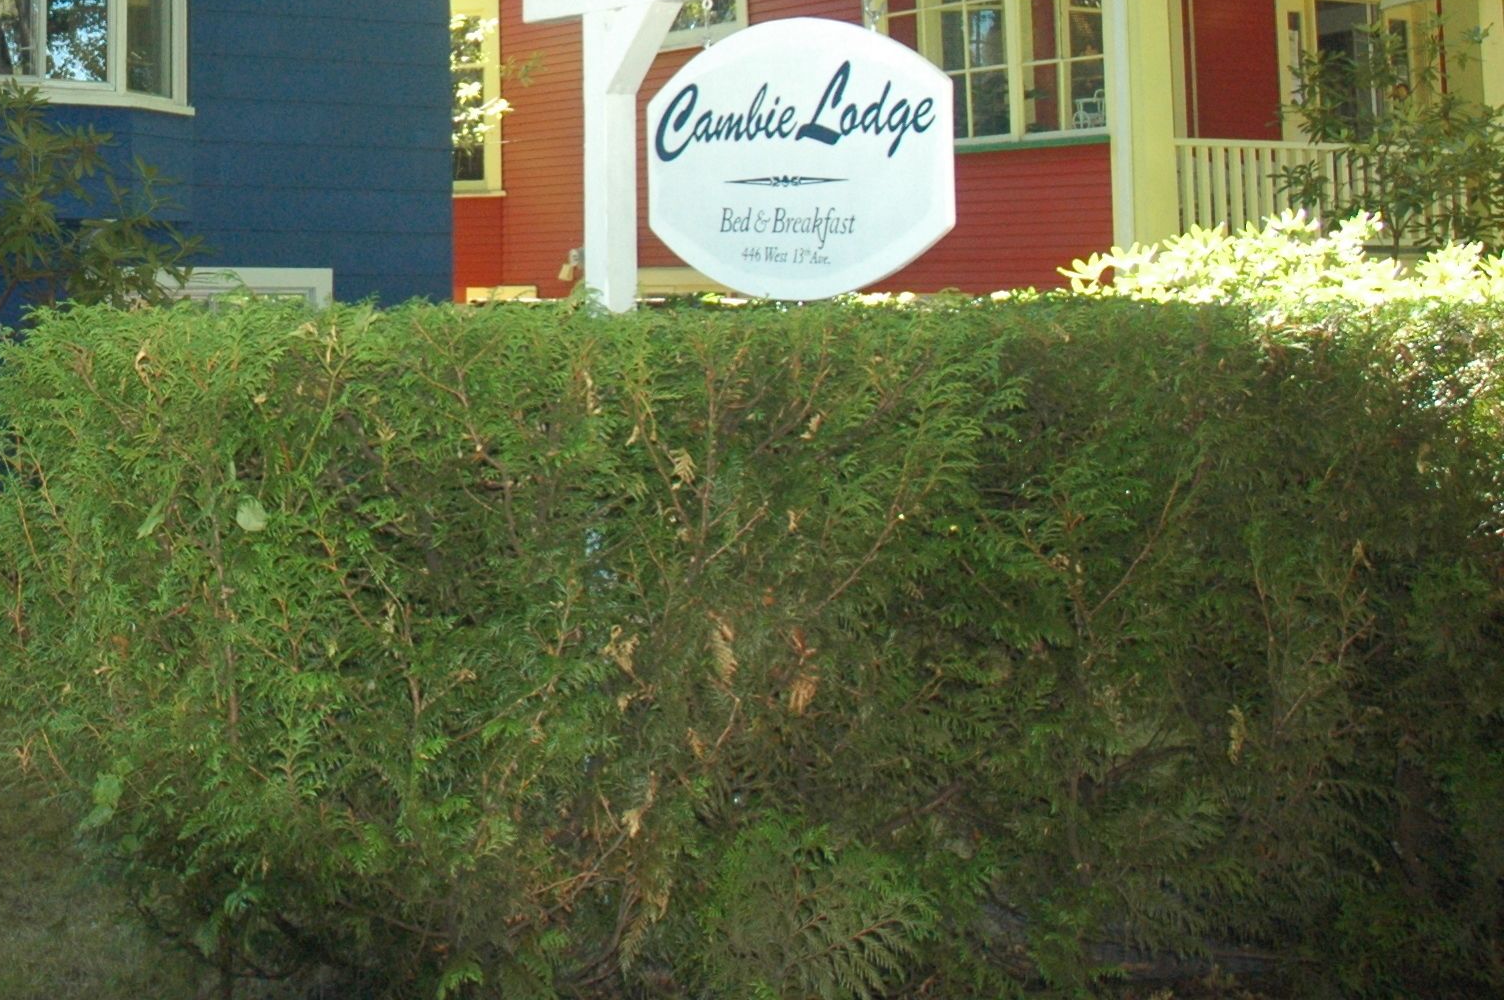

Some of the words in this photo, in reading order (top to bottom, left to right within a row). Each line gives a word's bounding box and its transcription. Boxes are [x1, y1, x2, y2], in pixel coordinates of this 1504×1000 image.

[655, 82, 797, 162] Cambie
[795, 60, 936, 158] Lodge
[719, 206, 752, 233] Bed
[753, 209, 771, 234] &
[771, 206, 856, 250] Breakfast
[741, 247, 762, 263] 446
[764, 246, 788, 264] West
